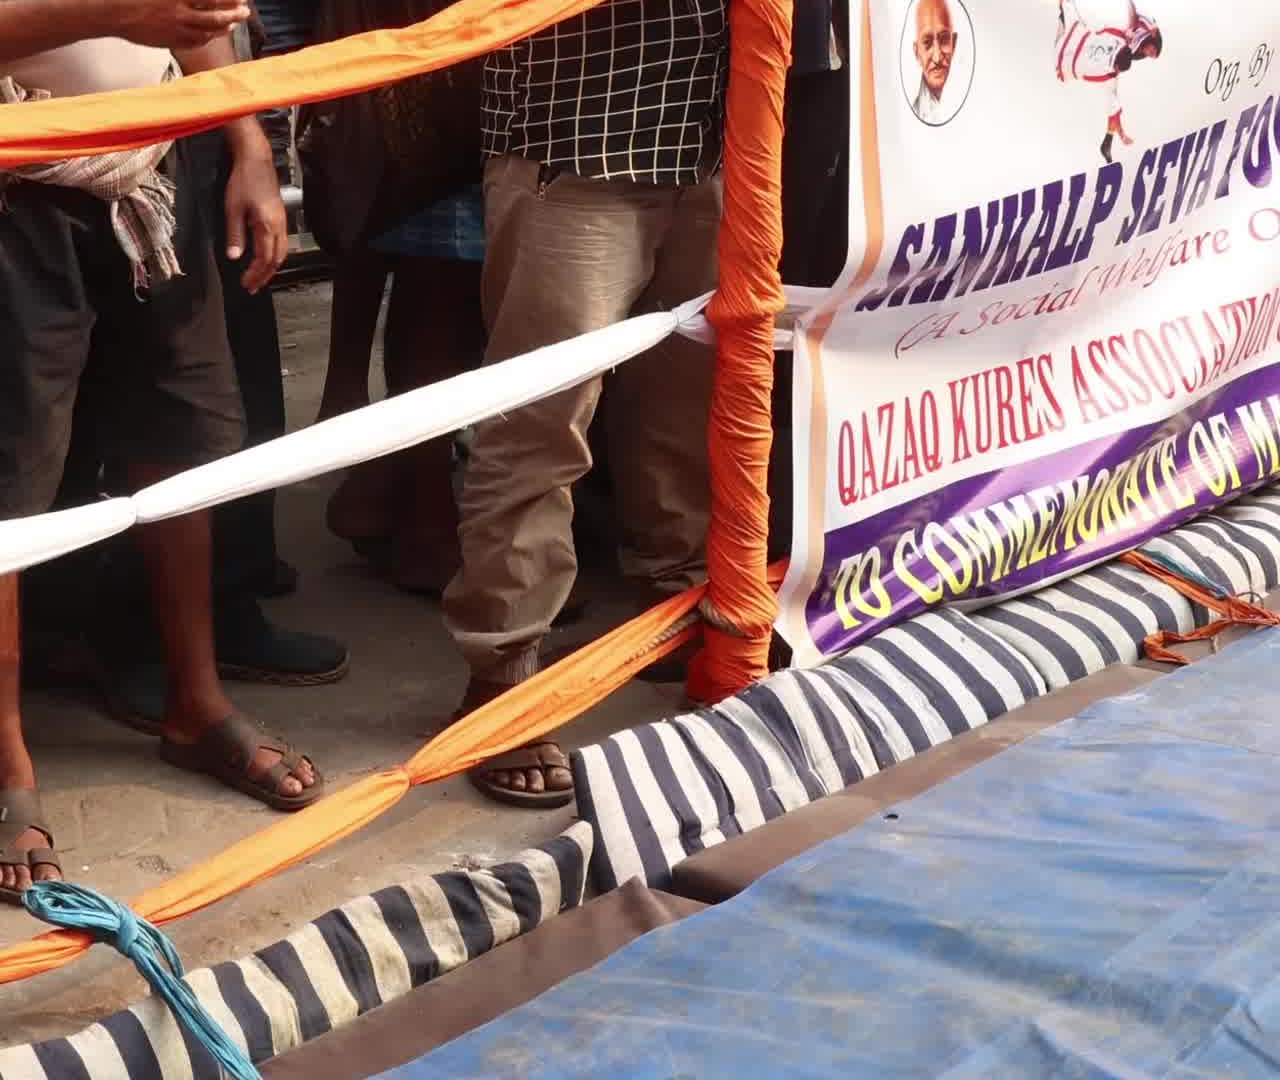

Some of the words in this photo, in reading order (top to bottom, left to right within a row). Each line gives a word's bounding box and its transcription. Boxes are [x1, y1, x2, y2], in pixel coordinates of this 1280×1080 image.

[1204, 57, 1241, 101] Org.
[1249, 42, 1275, 87] By
[854, 161, 1123, 313] SANKALP
[1114, 119, 1228, 246] SEVA
[960, 264, 1099, 336] Social
[1094, 224, 1232, 296] Welfare
[837, 389, 944, 506] QAZAQ
[947, 352, 1067, 464] KURES
[832, 545, 893, 630] TO
[892, 431, 1197, 605] COMMEMORATE
[1187, 413, 1242, 497] OF
